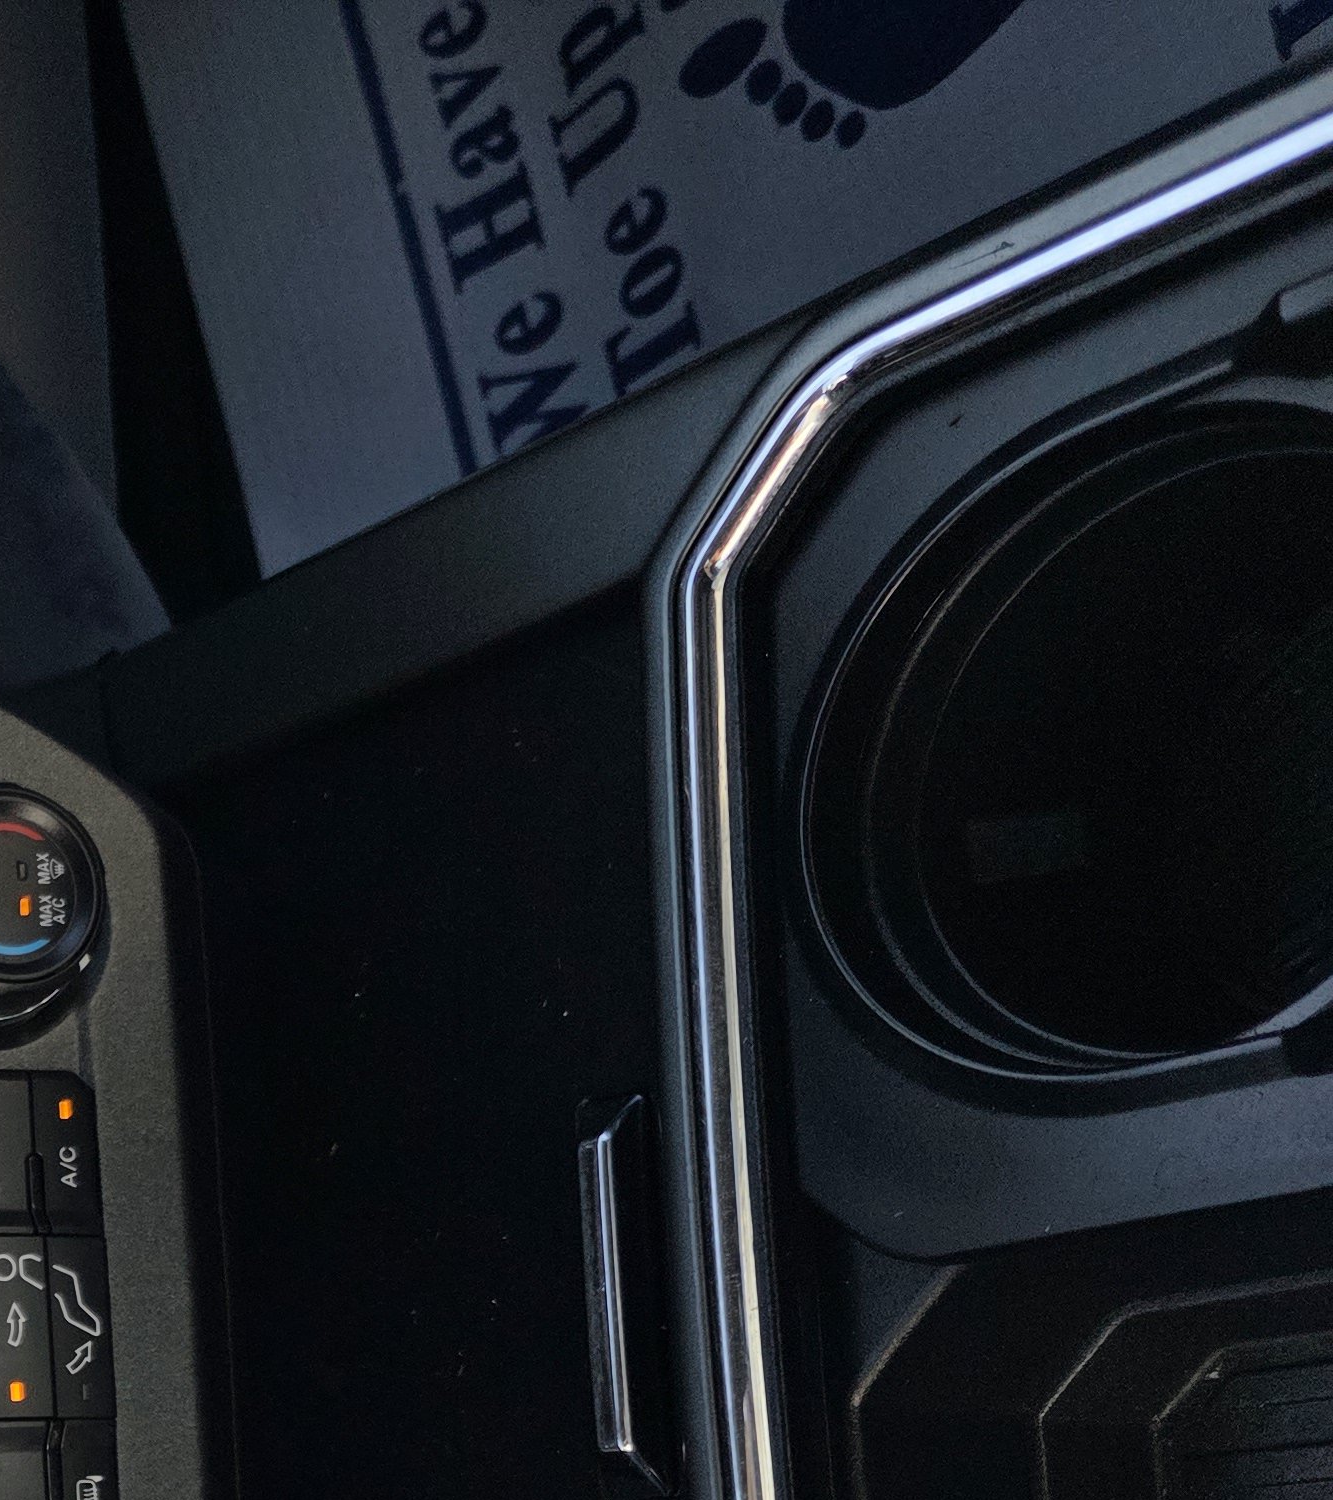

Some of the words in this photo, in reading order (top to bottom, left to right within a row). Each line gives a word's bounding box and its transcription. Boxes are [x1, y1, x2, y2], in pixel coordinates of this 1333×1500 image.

[410, 1, 546, 293] Have
[546, 2, 647, 197] Up
[600, 184, 701, 398] Toe
[480, 291, 591, 459] We
[35, 853, 51, 884] MAX
[38, 895, 53, 927] MAX
[51, 898, 67, 924] A/C
[59, 1146, 78, 1188] A/C
